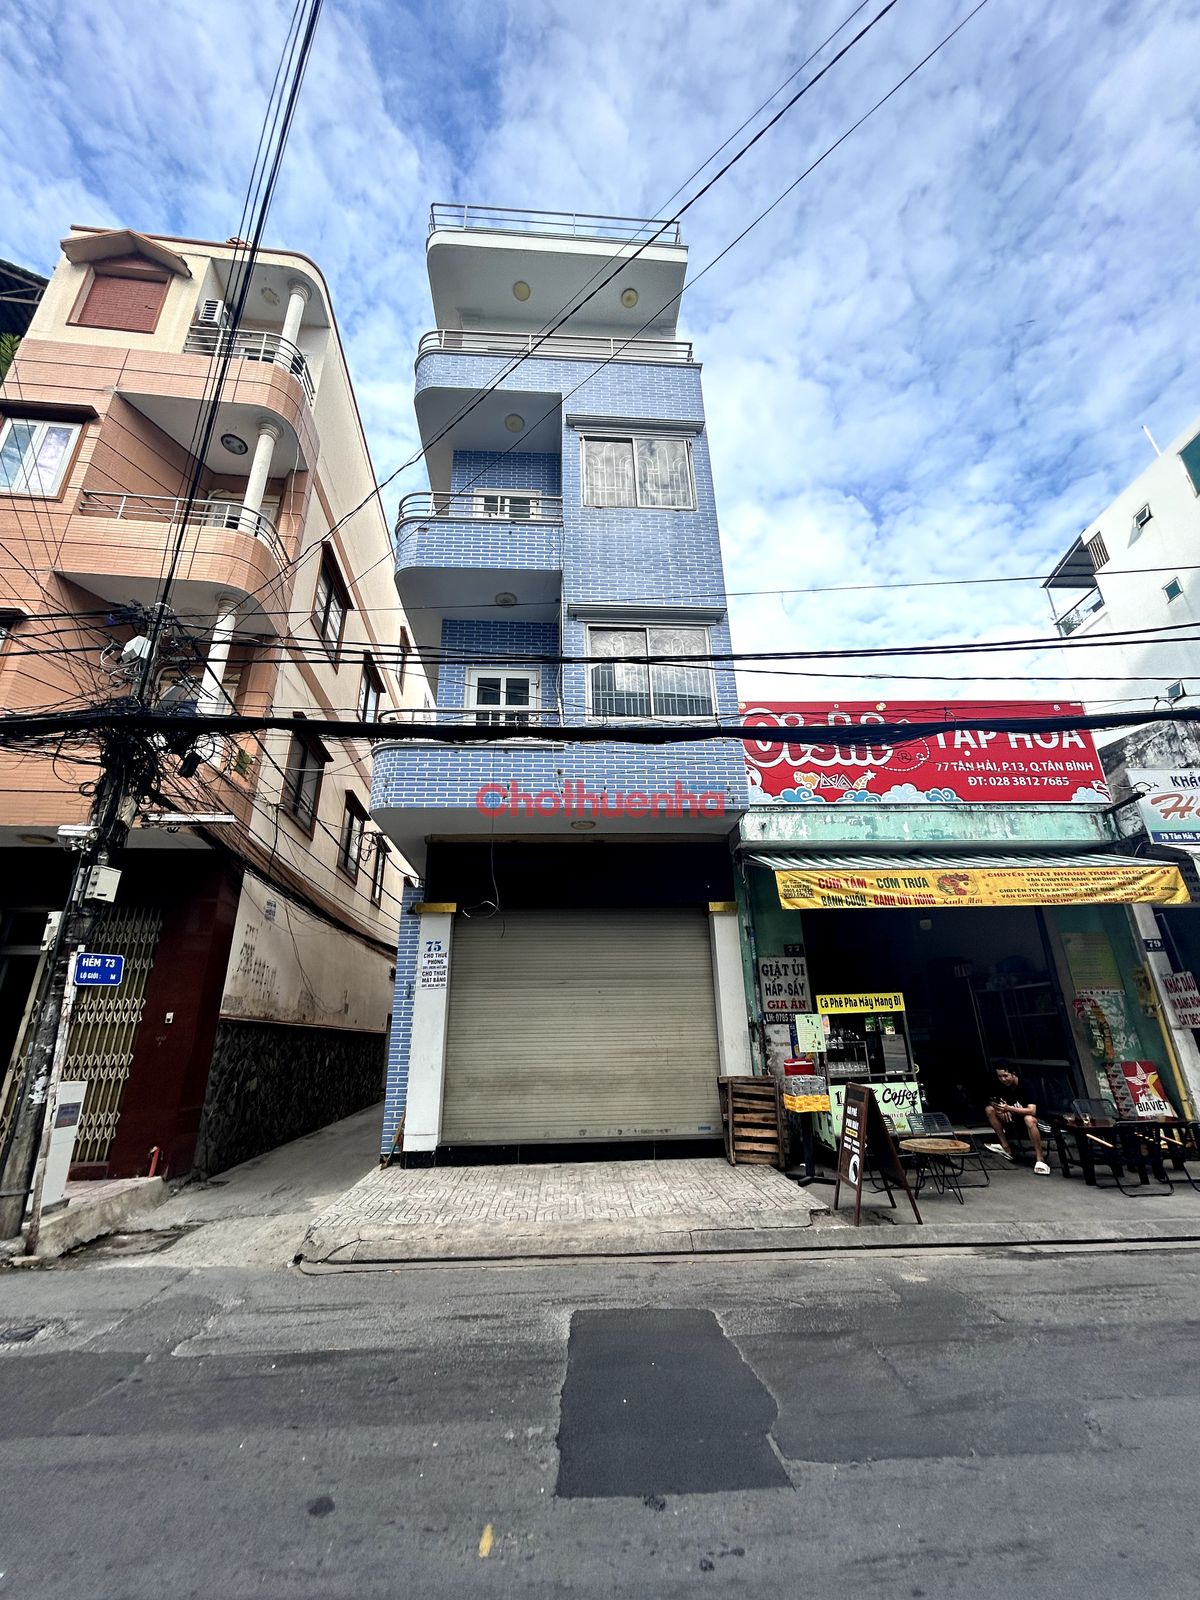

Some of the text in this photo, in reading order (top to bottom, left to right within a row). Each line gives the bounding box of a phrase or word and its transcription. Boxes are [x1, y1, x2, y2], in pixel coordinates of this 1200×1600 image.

[936, 759, 1095, 773] 77 TÂN HẢI, P.13, Q.TÂN BÌNH
[967, 776, 1070, 786] ĐT: 028 3812 7685
[1170, 771, 1200, 788] KHẮ
[1160, 832, 1170, 840] 79
[876, 876, 900, 889] CƠM
[901, 876, 930, 889] TRƯA
[426, 941, 442, 952] 75
[1146, 940, 1162, 948] 79
[82, 955, 116, 968] HẺM 73
[761, 958, 805, 980] GIẶT ỦI
[767, 1000, 788, 1010] GIA
[820, 995, 901, 1009] Cà Phê Pha Máy Mang Đi
[765, 1013, 776, 1022] LH:
[775, 1013, 789, 1022] 0785
[882, 1088, 918, 1106] Coffee
[1137, 1099, 1168, 1112] BIA VIỆT
